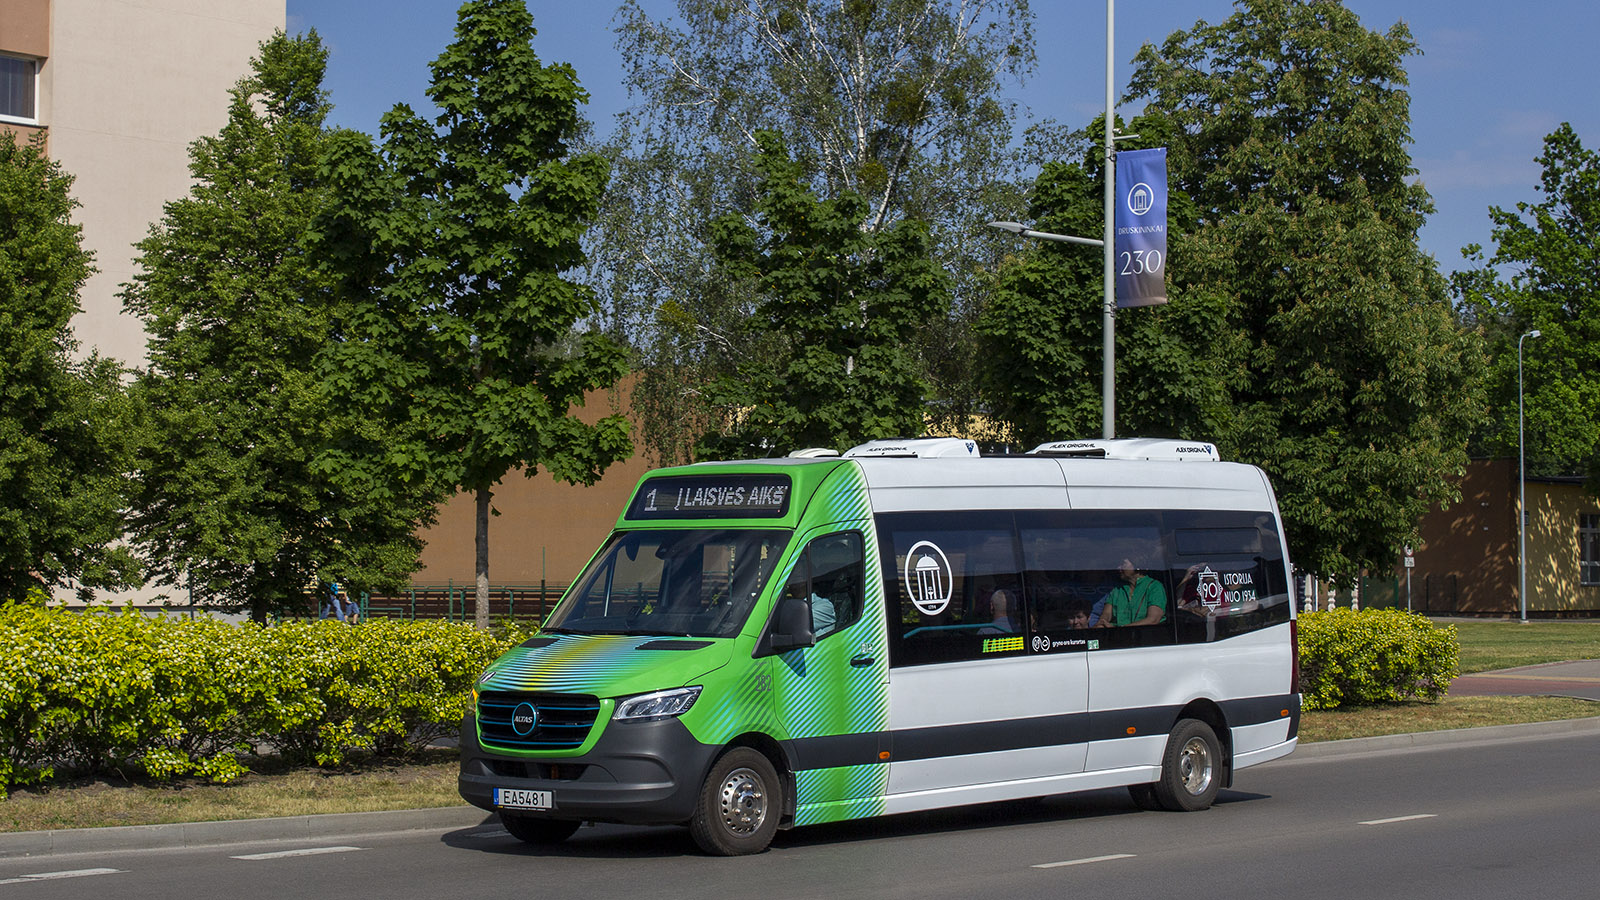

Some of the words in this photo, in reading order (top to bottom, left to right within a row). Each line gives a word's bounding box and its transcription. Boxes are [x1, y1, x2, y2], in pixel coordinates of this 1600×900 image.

[1118, 225, 1163, 235] DRUSKININKAI
[1120, 249, 1162, 276] 230
[644, 488, 657, 511] 1
[684, 486, 745, 507] LAISVĖS
[1202, 582, 1218, 598] 90
[1224, 590, 1241, 603] NUO
[1242, 589, 1257, 602] 1934
[755, 674, 772, 692] 282
[513, 715, 533, 724] ALTAS
[503, 790, 545, 806] EA5481
